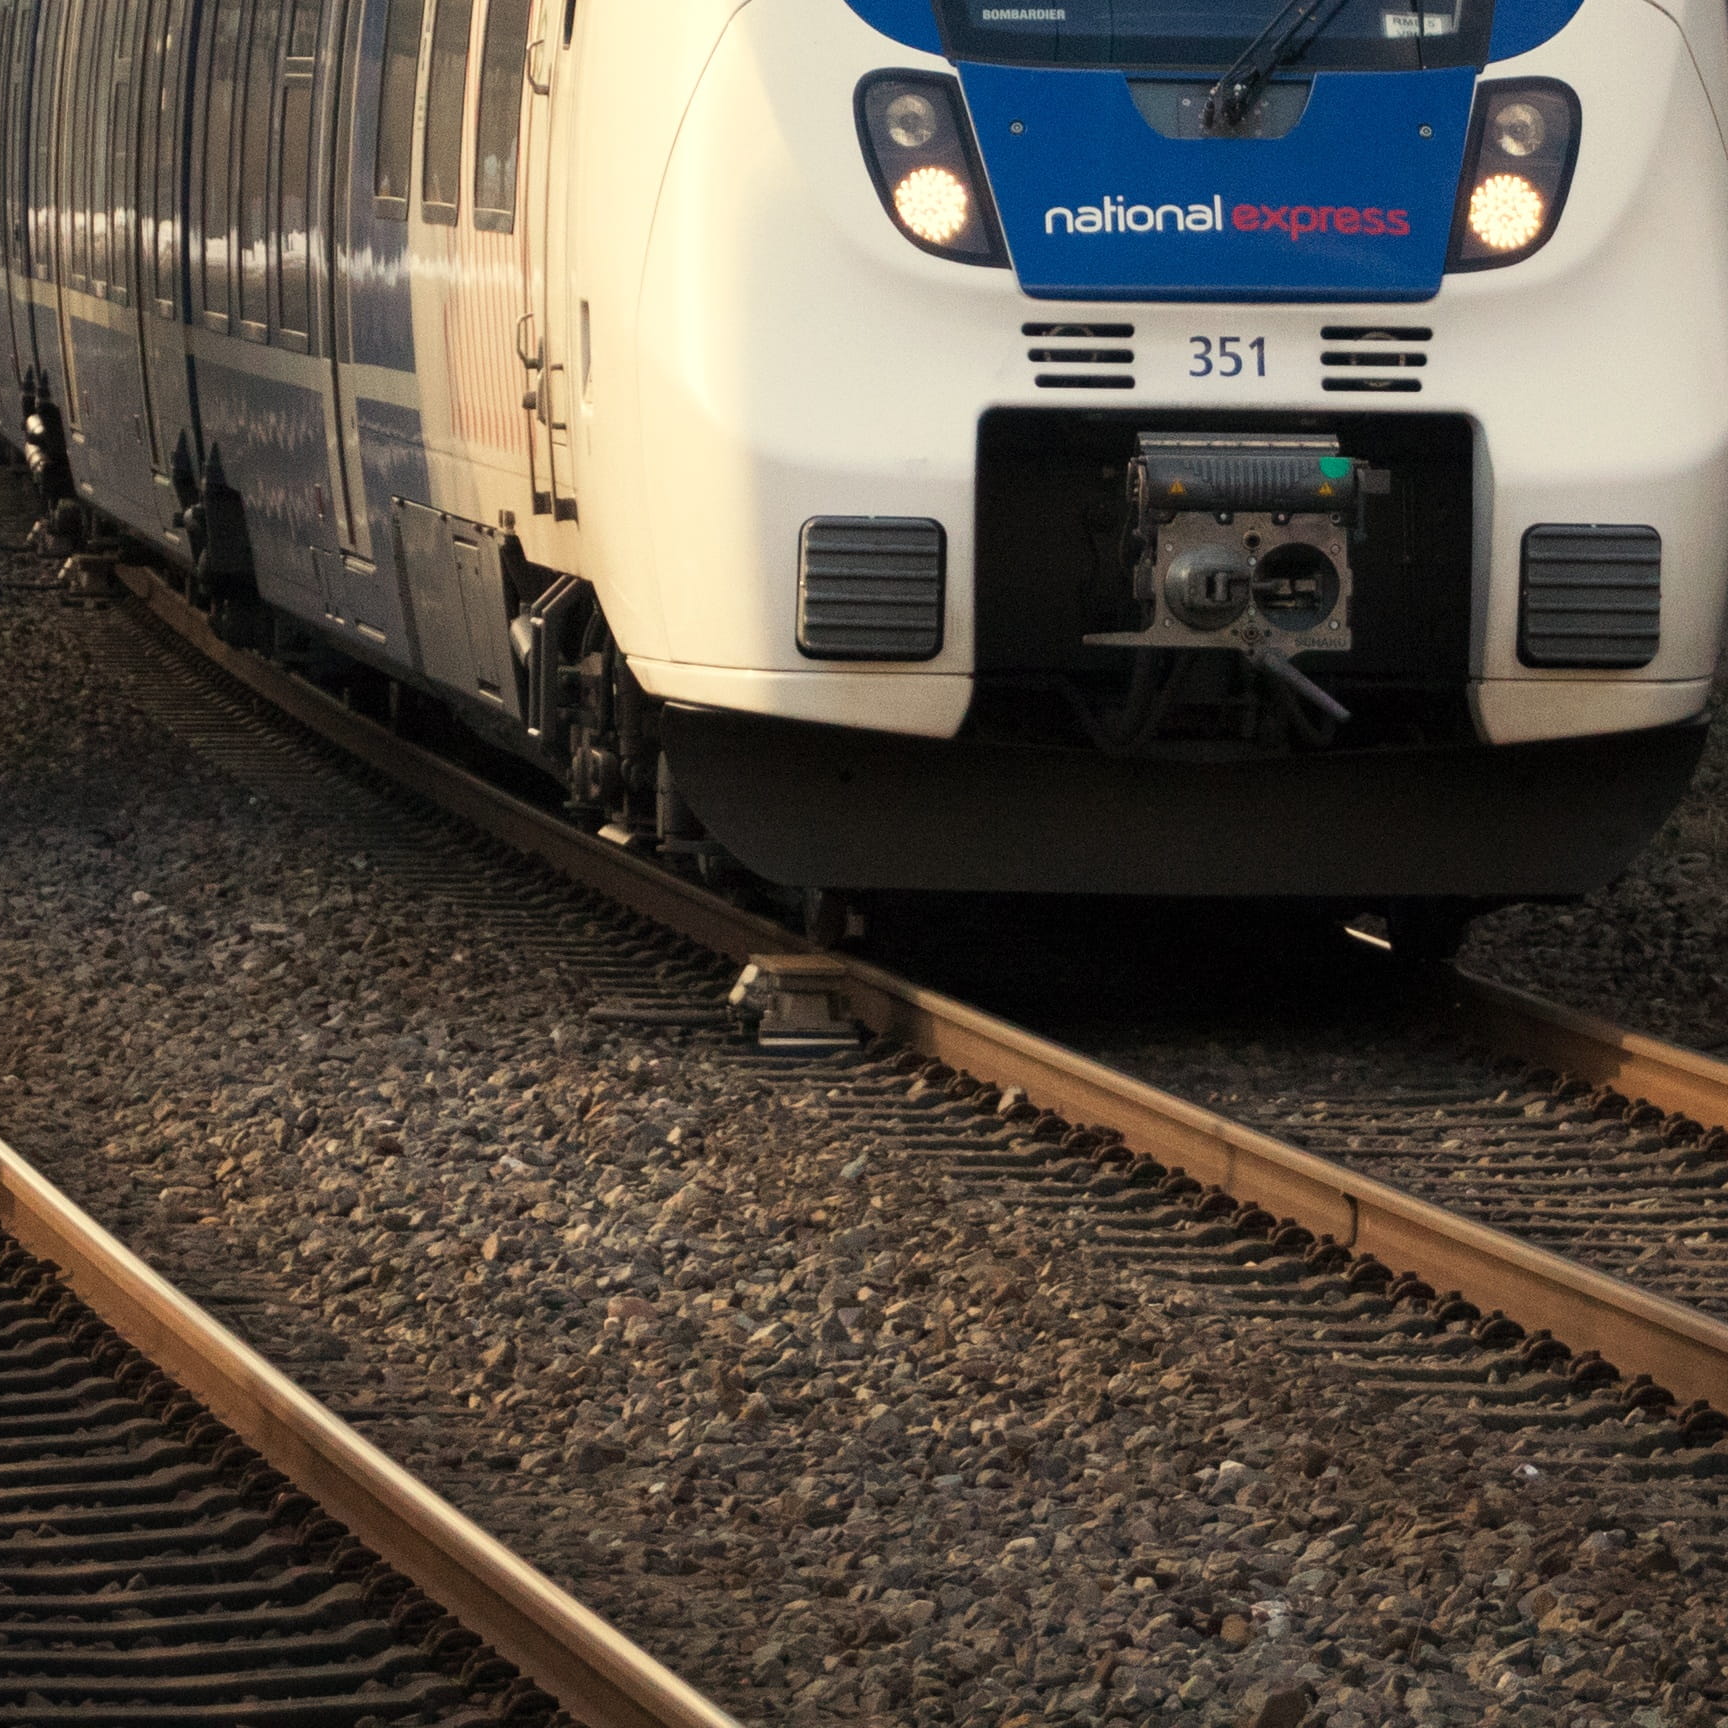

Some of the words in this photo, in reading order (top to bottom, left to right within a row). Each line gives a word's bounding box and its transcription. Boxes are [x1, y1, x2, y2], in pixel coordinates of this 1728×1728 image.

[981, 8, 1067, 22] BOMBARDIER
[1044, 193, 1223, 235] national
[1230, 203, 1411, 242] express
[1188, 335, 1266, 378] 351
